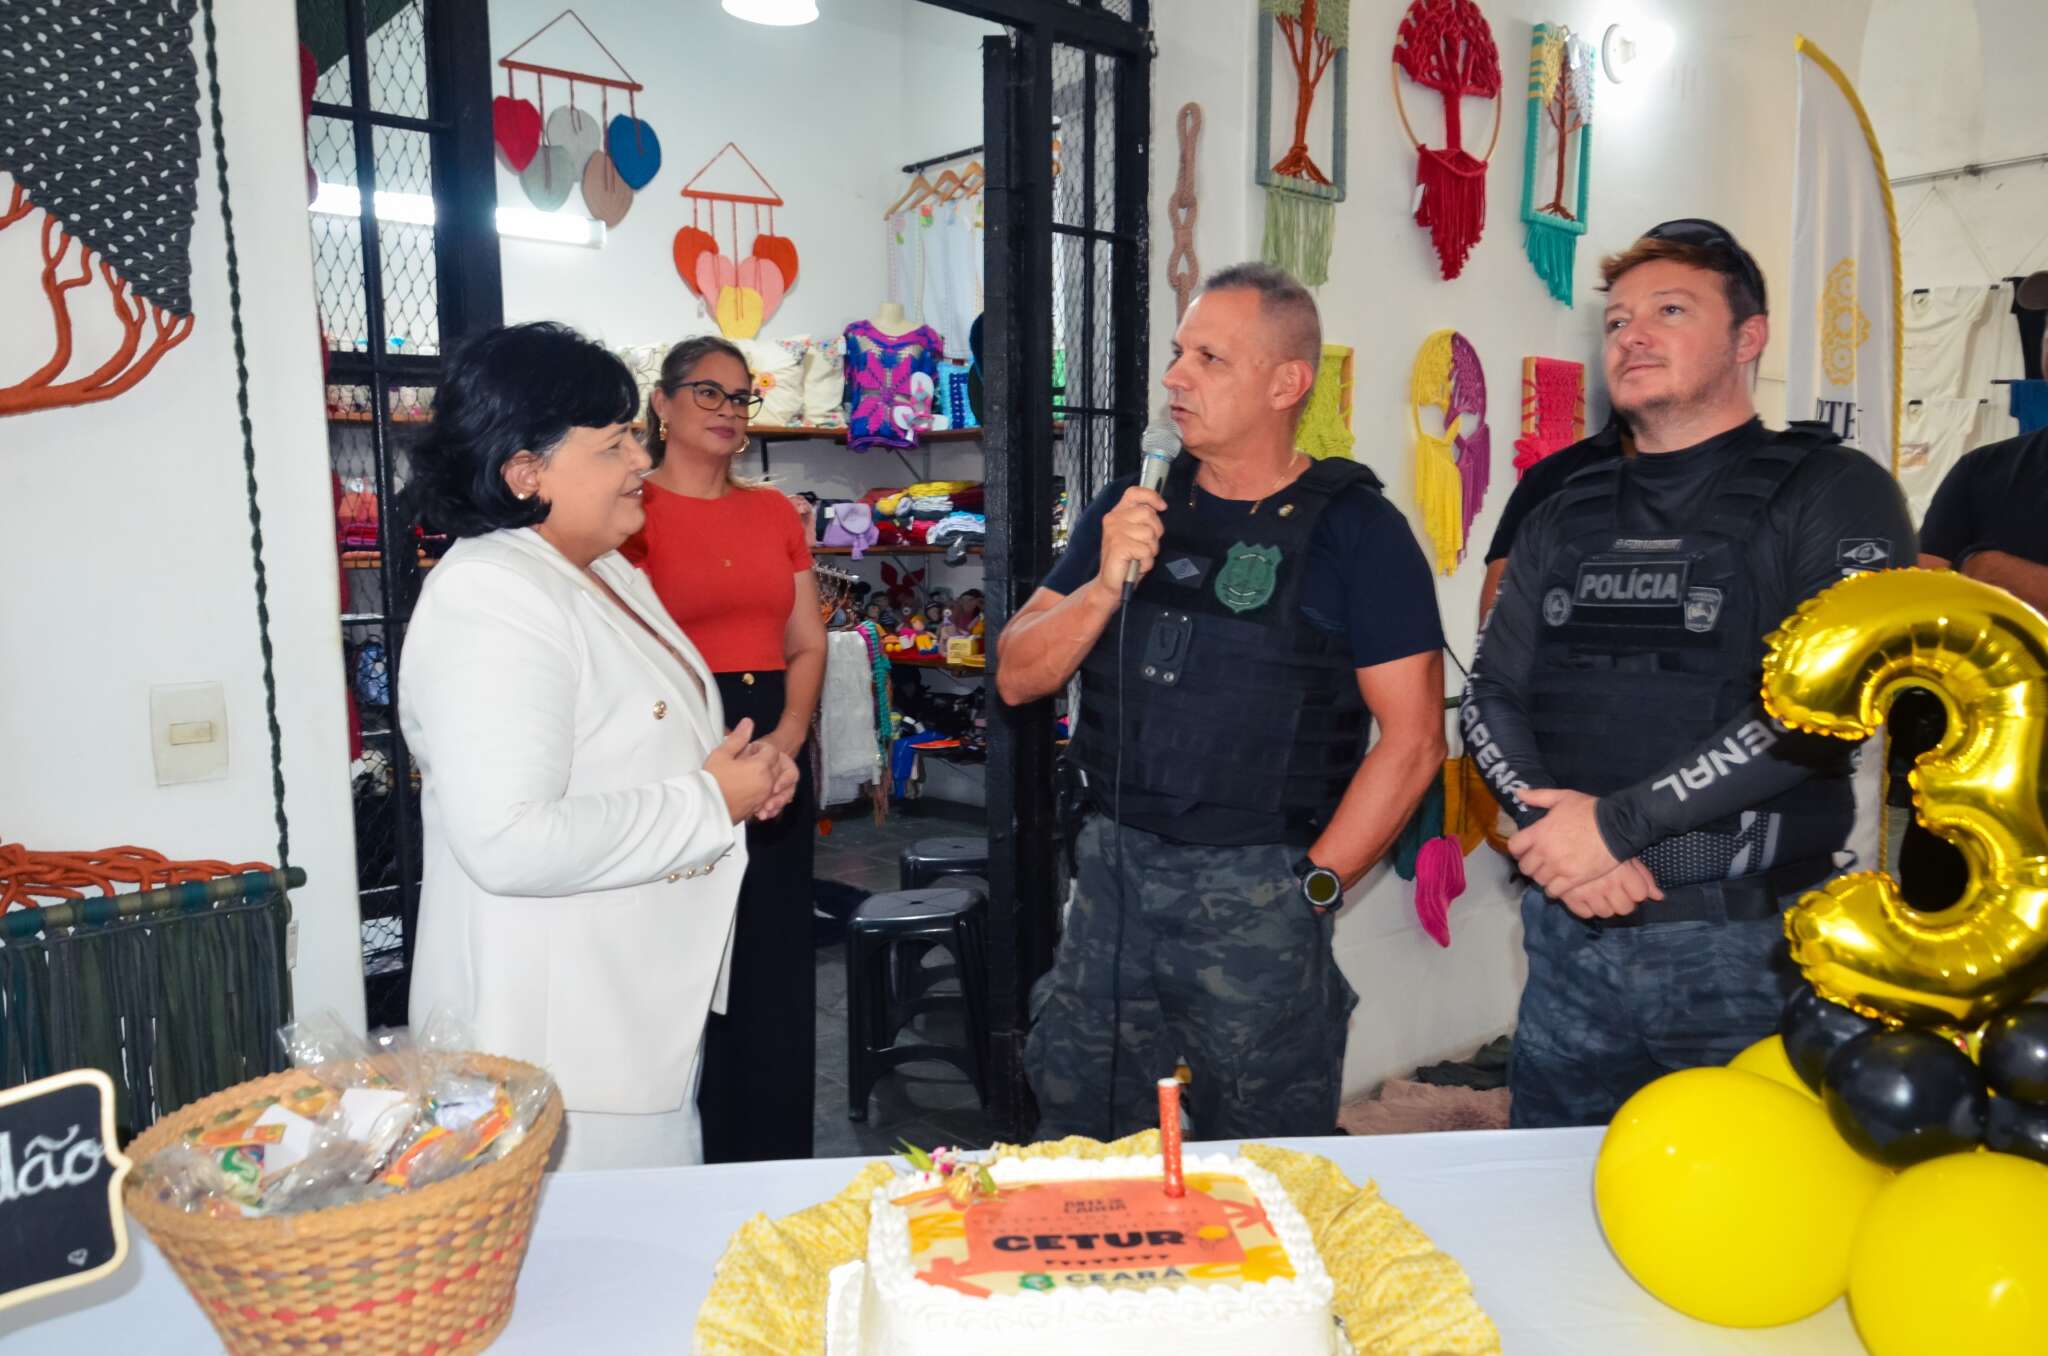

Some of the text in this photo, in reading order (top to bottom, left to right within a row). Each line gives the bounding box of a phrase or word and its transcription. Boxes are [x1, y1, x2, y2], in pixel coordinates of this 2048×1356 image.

[1579, 567, 1678, 600] POLÍCIA
[1651, 718, 1790, 802] ENAL
[993, 1231, 1184, 1251] CETUR
